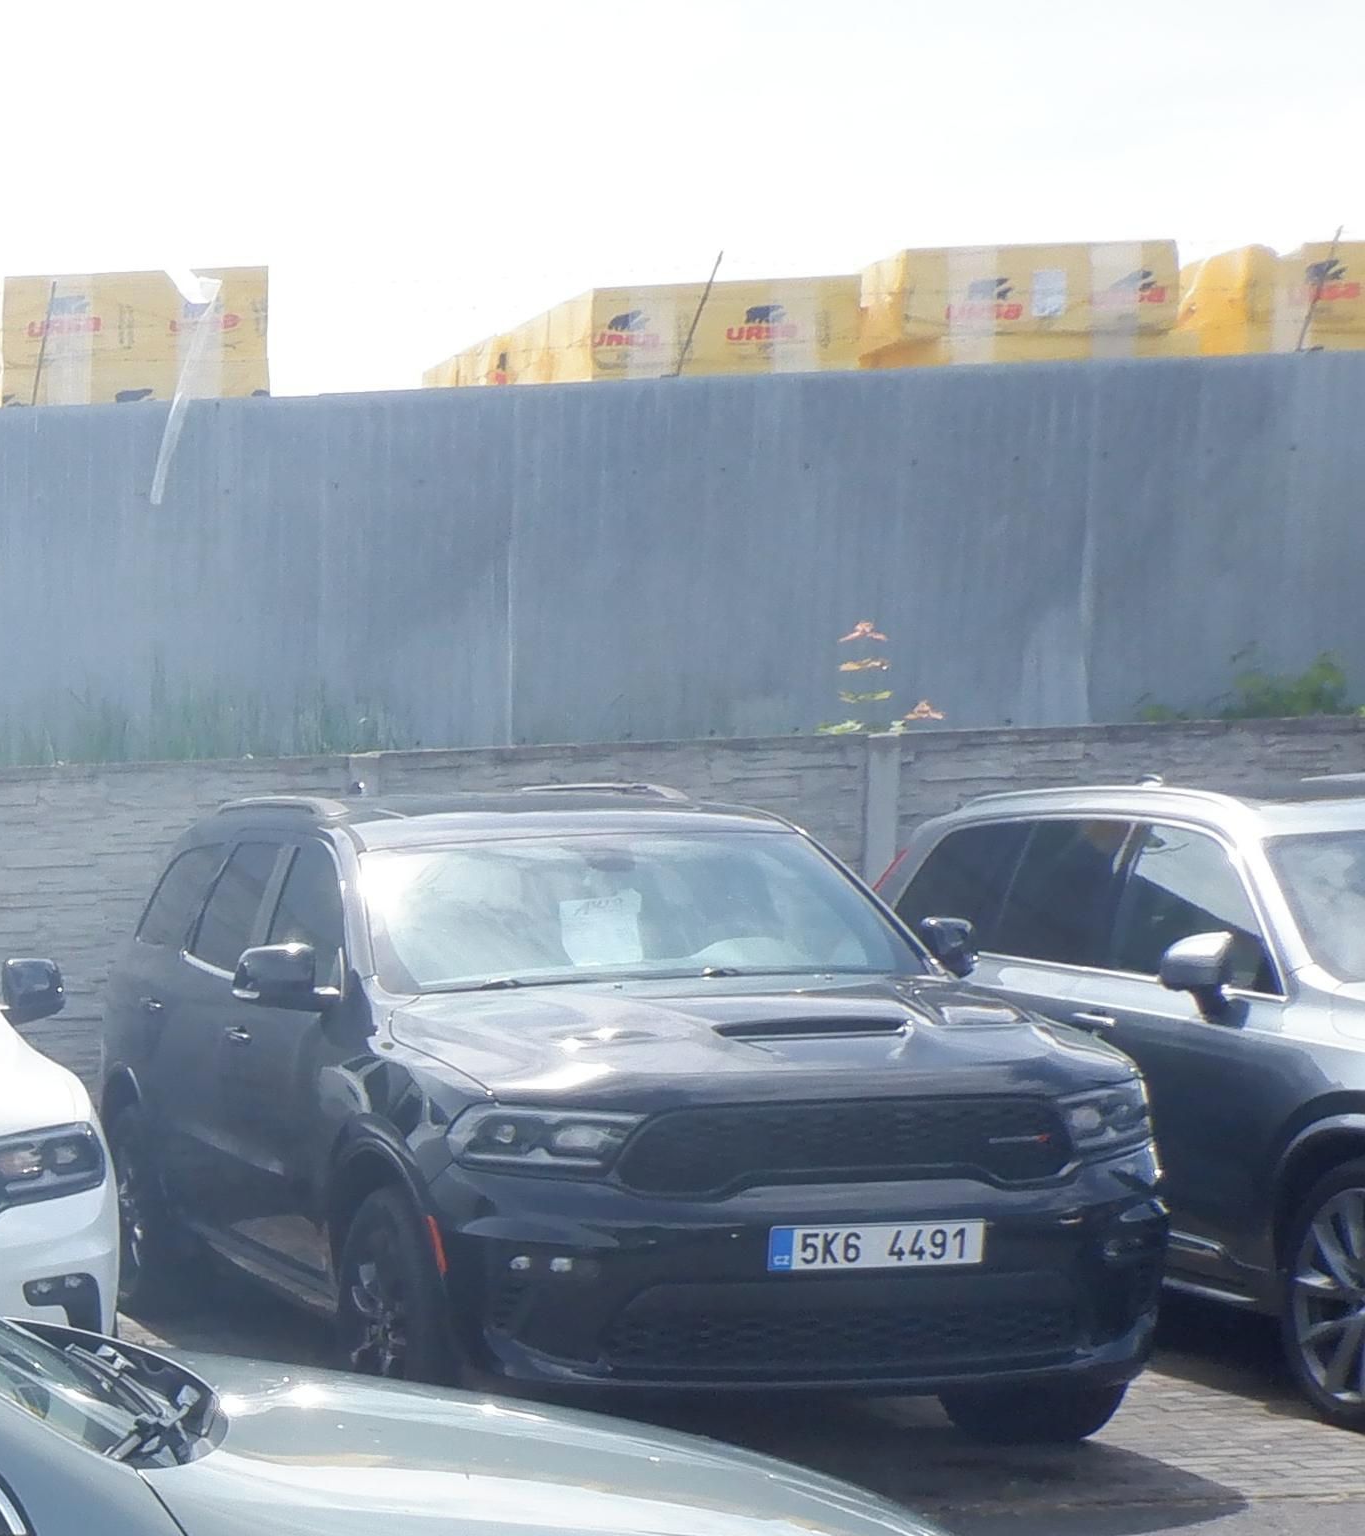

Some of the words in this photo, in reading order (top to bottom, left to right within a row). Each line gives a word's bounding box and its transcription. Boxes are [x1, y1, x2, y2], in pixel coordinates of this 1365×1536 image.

[725, 322, 799, 342] URSA
[800, 1231, 862, 1264] 5K6
[887, 1227, 967, 1262] 4491
[772, 1255, 791, 1266] CZ
